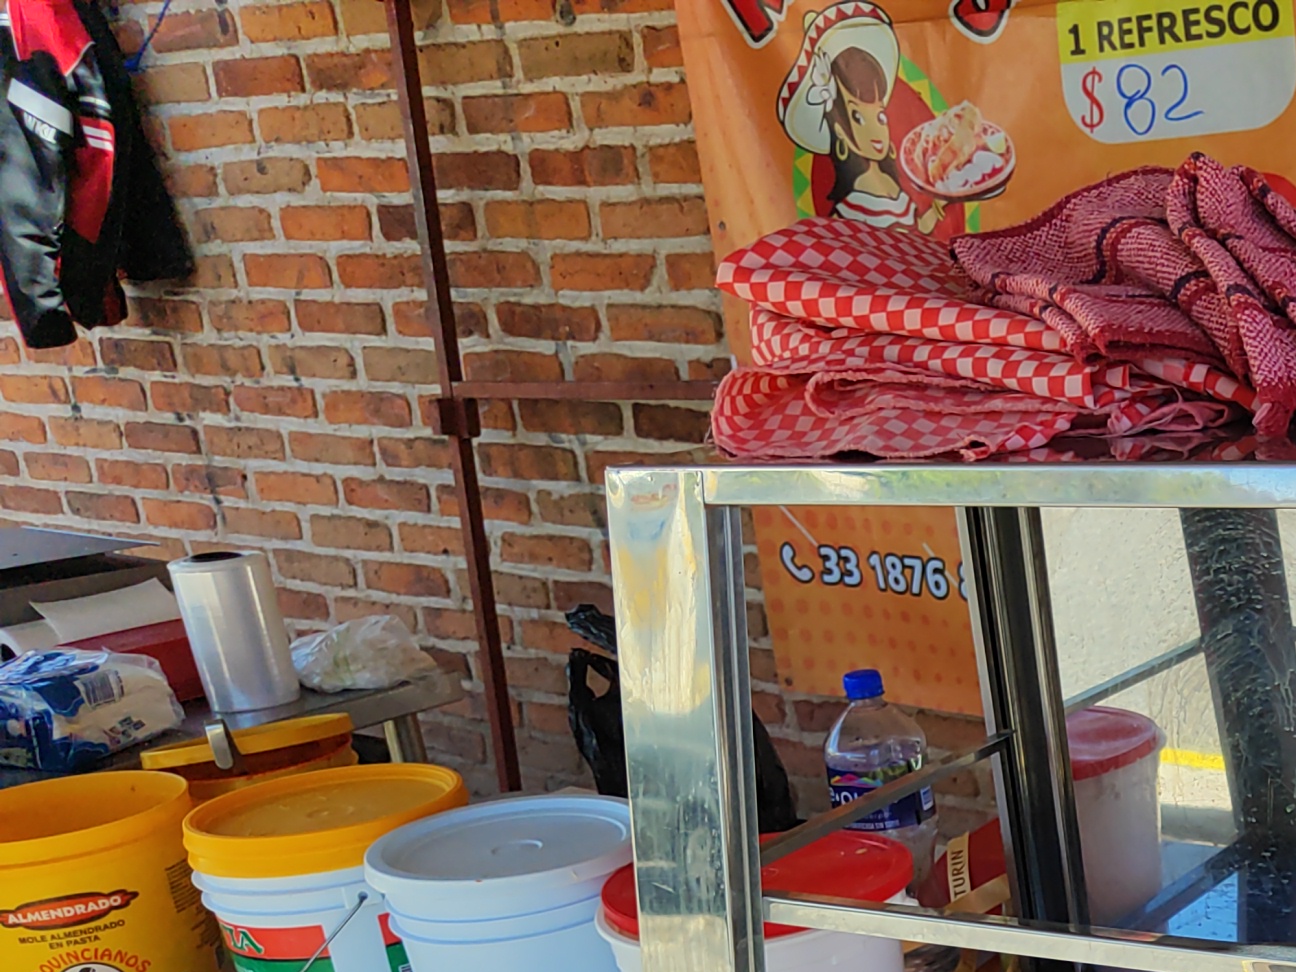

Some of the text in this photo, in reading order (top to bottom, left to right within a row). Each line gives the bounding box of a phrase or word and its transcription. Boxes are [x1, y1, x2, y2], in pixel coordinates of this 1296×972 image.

[1068, 0, 1280, 56] 1 REFRESCO
[819, 545, 862, 588] 33
[868, 552, 950, 600] 1876
[951, 848, 968, 899] TURIN
[7, 895, 123, 925] ALMENDRADO
[18, 918, 126, 945] MOLE ALMENDRADO
[49, 934, 102, 950] EN PASTA
